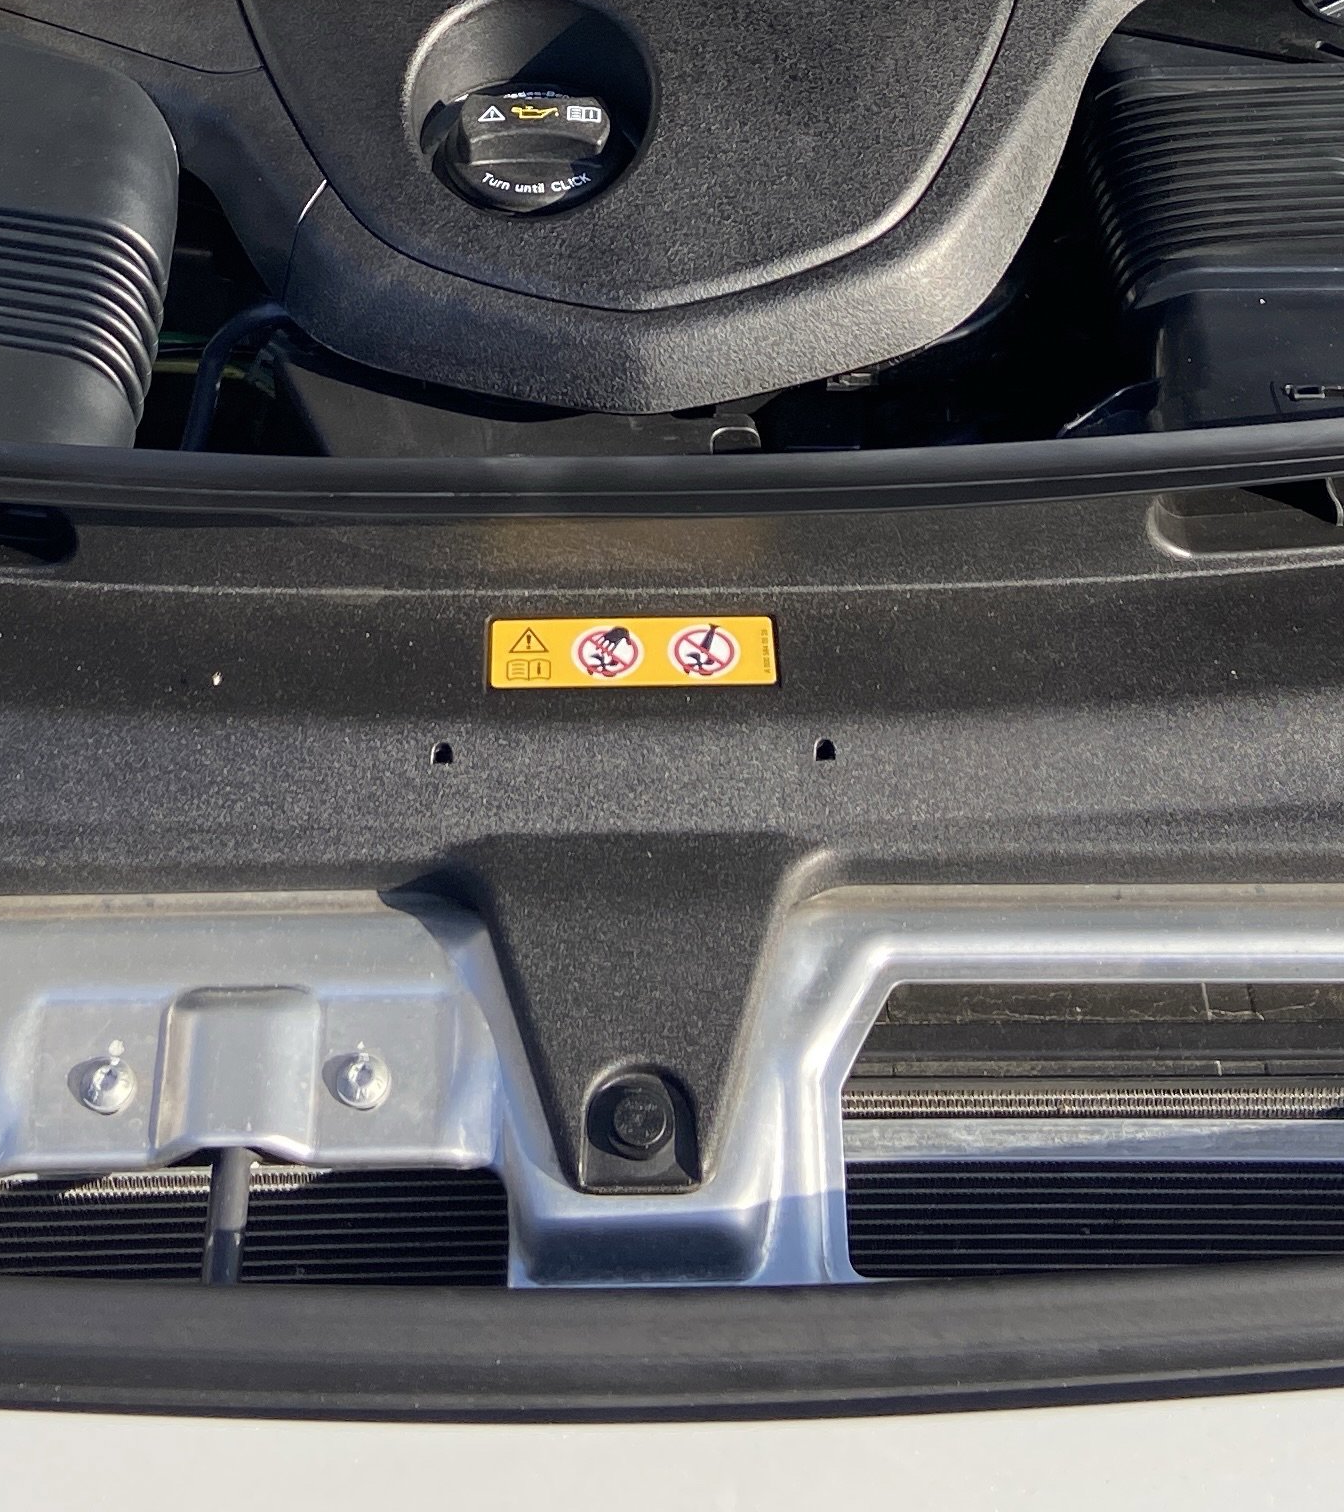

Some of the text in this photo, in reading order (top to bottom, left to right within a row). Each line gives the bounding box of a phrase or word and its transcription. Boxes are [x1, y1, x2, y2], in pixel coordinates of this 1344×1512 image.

[482, 172, 592, 194] Turn until CLICK
